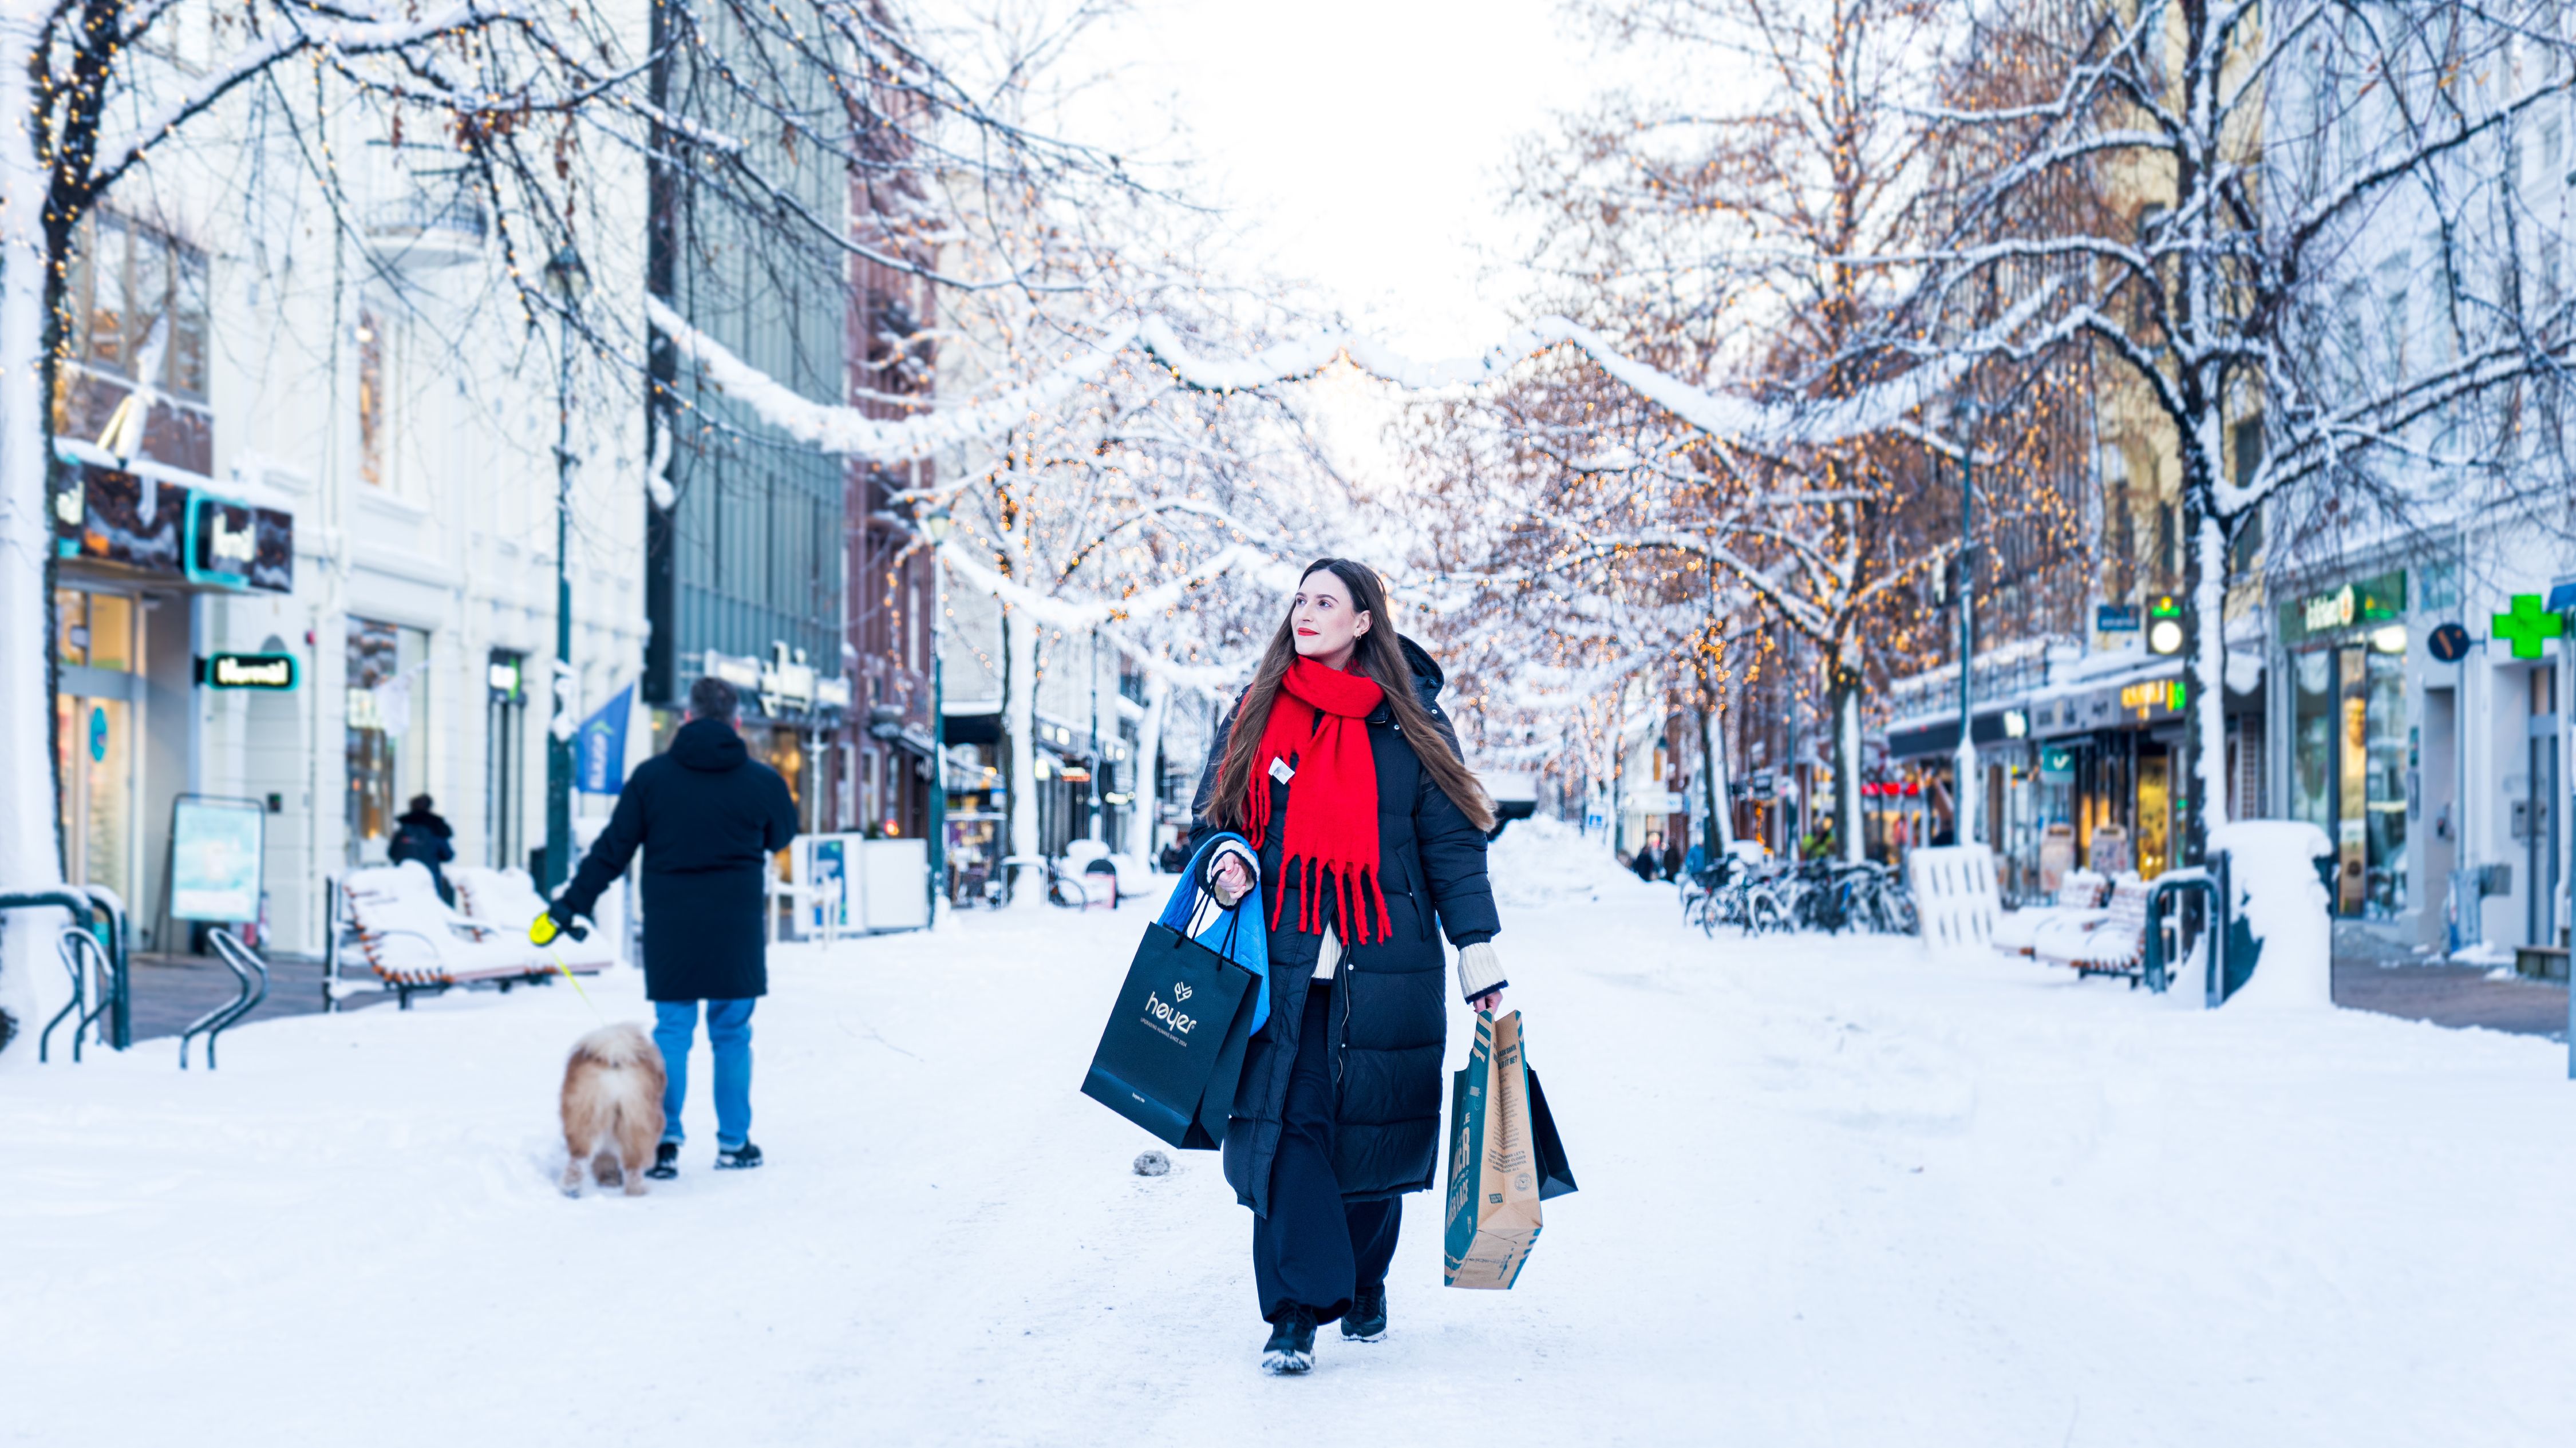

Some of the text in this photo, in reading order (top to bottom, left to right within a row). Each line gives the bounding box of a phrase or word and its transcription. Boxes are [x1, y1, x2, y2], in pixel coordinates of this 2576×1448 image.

[1145, 991, 1196, 1034] høyer
[1157, 1027, 1170, 1038] HUMANS
[1170, 1034, 1179, 1043] SINCE
